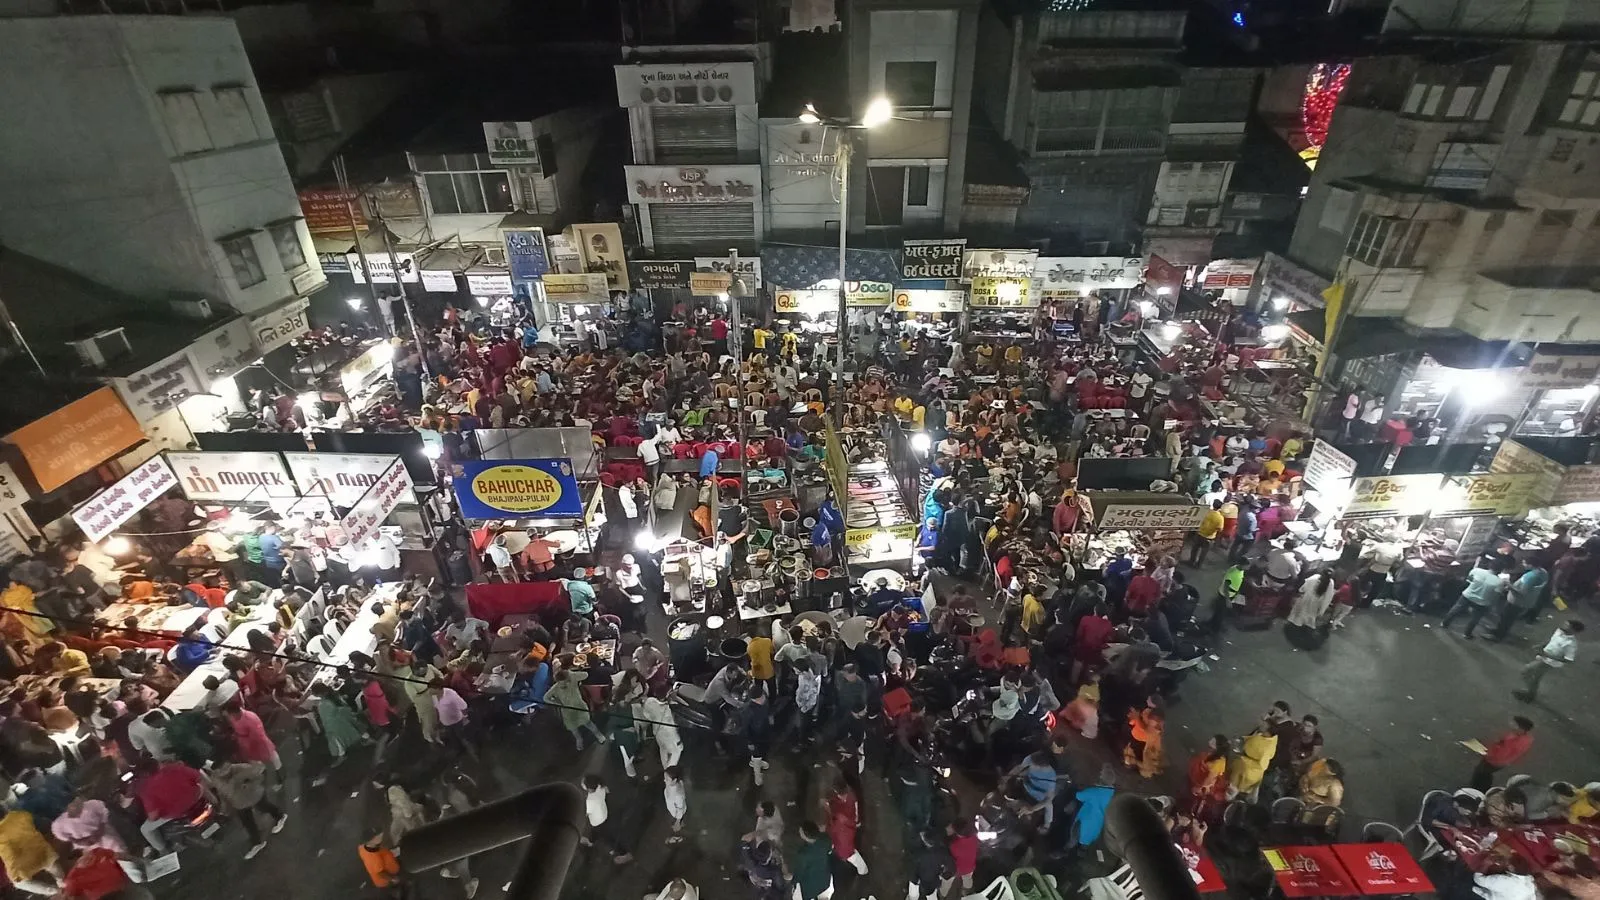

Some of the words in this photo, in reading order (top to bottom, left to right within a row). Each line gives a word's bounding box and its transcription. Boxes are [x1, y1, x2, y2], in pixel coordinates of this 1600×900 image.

[682, 172, 701, 180] JSP
[643, 263, 681, 273] ભગવતી
[279, 311, 304, 335] સ્ટોર્સ
[218, 471, 285, 486] MANEK
[336, 473, 379, 487] MAN
[477, 479, 555, 494] BAHUCHAR
[487, 495, 550, 503] BHAJIPAV-PULAV
[1117, 507, 1200, 518] મહાલક્ષ્મી
